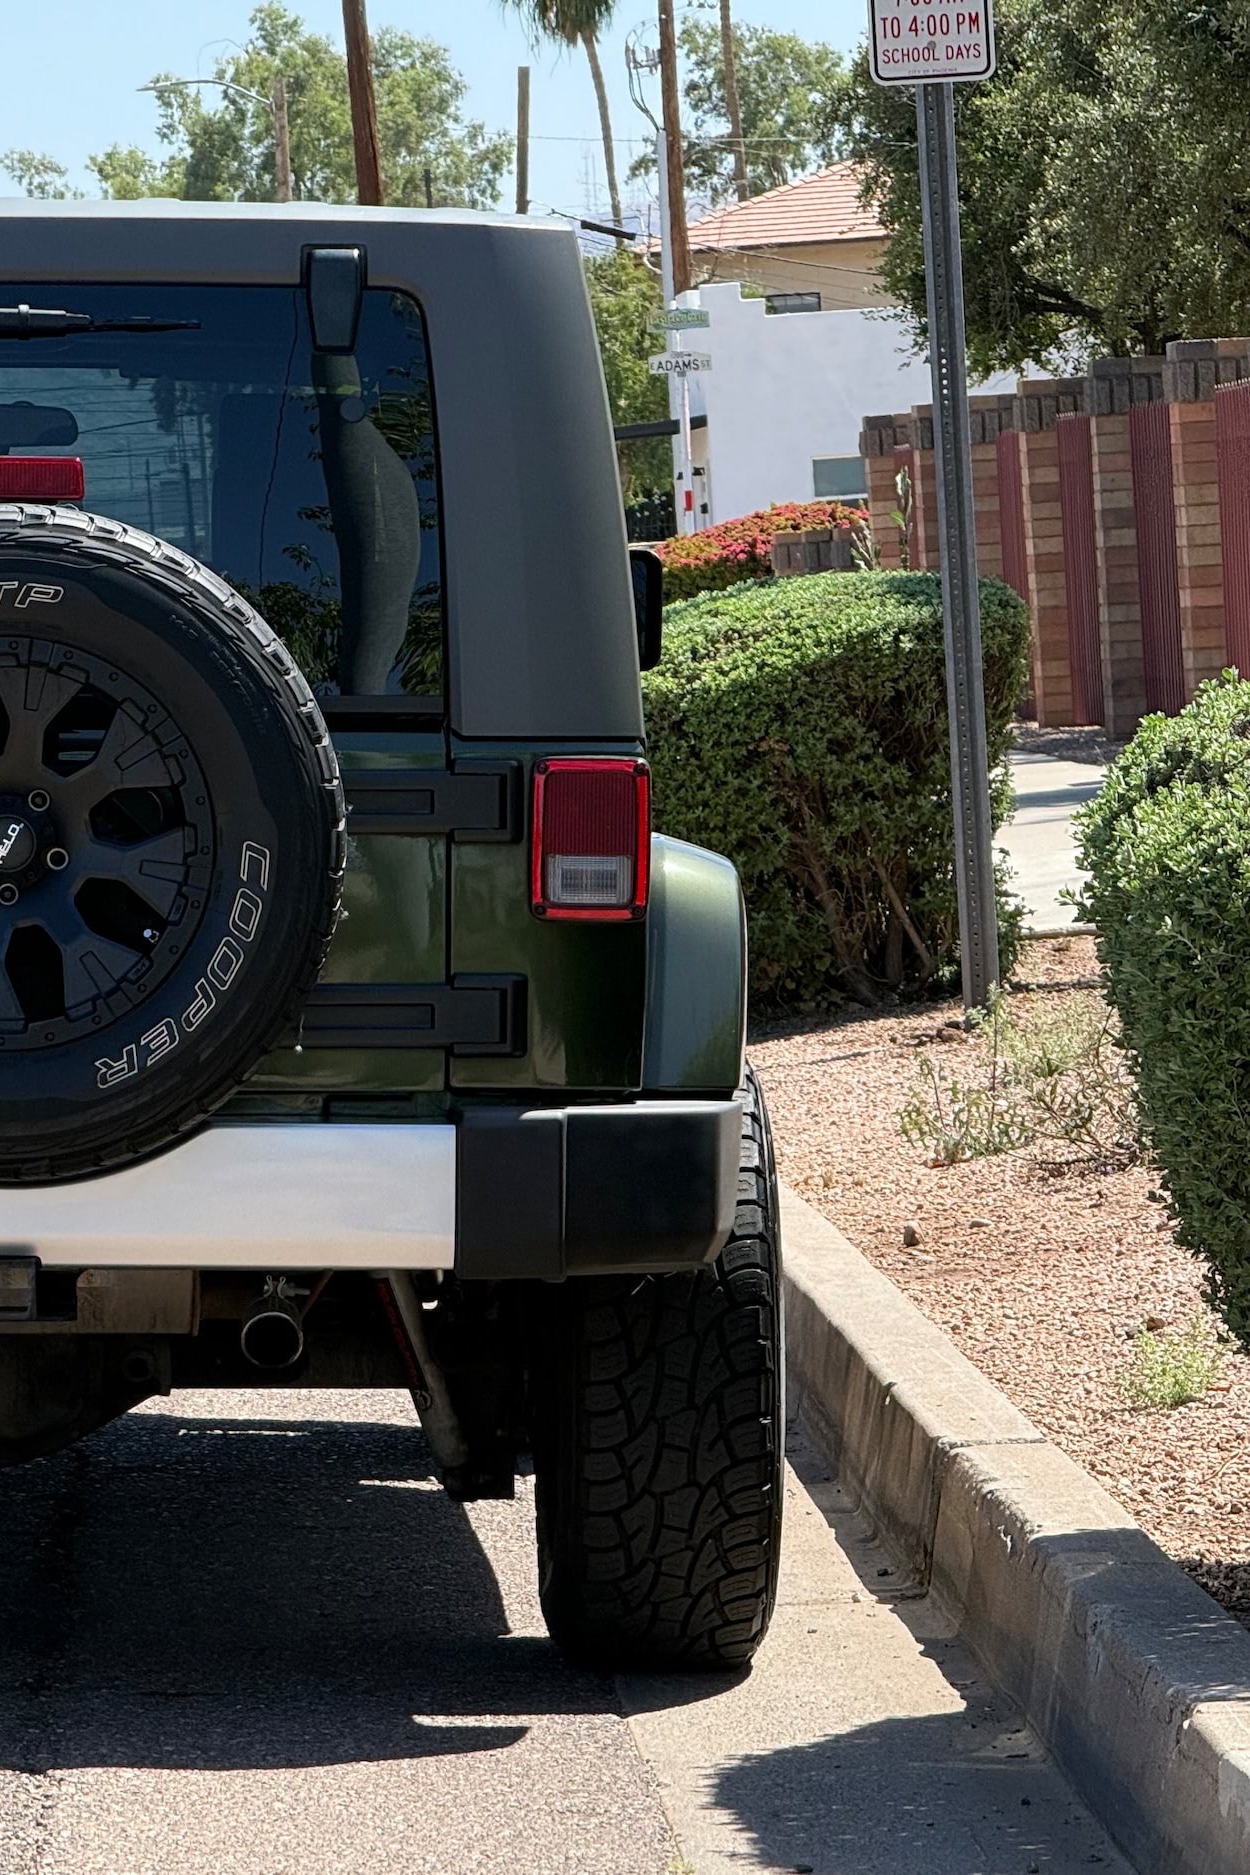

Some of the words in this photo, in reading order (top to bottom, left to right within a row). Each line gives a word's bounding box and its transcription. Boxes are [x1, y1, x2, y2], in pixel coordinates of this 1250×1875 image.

[880, 16, 901, 39] TO
[908, 13, 950, 37] 4:00
[956, 11, 980, 34] PM
[882, 47, 940, 64] SCHOOL
[946, 43, 981, 60] DAYS
[650, 362, 655, 370] E
[656, 358, 700, 371] ADAMS
[701, 360, 711, 368] ST
[94, 840, 271, 1089] COOPER
